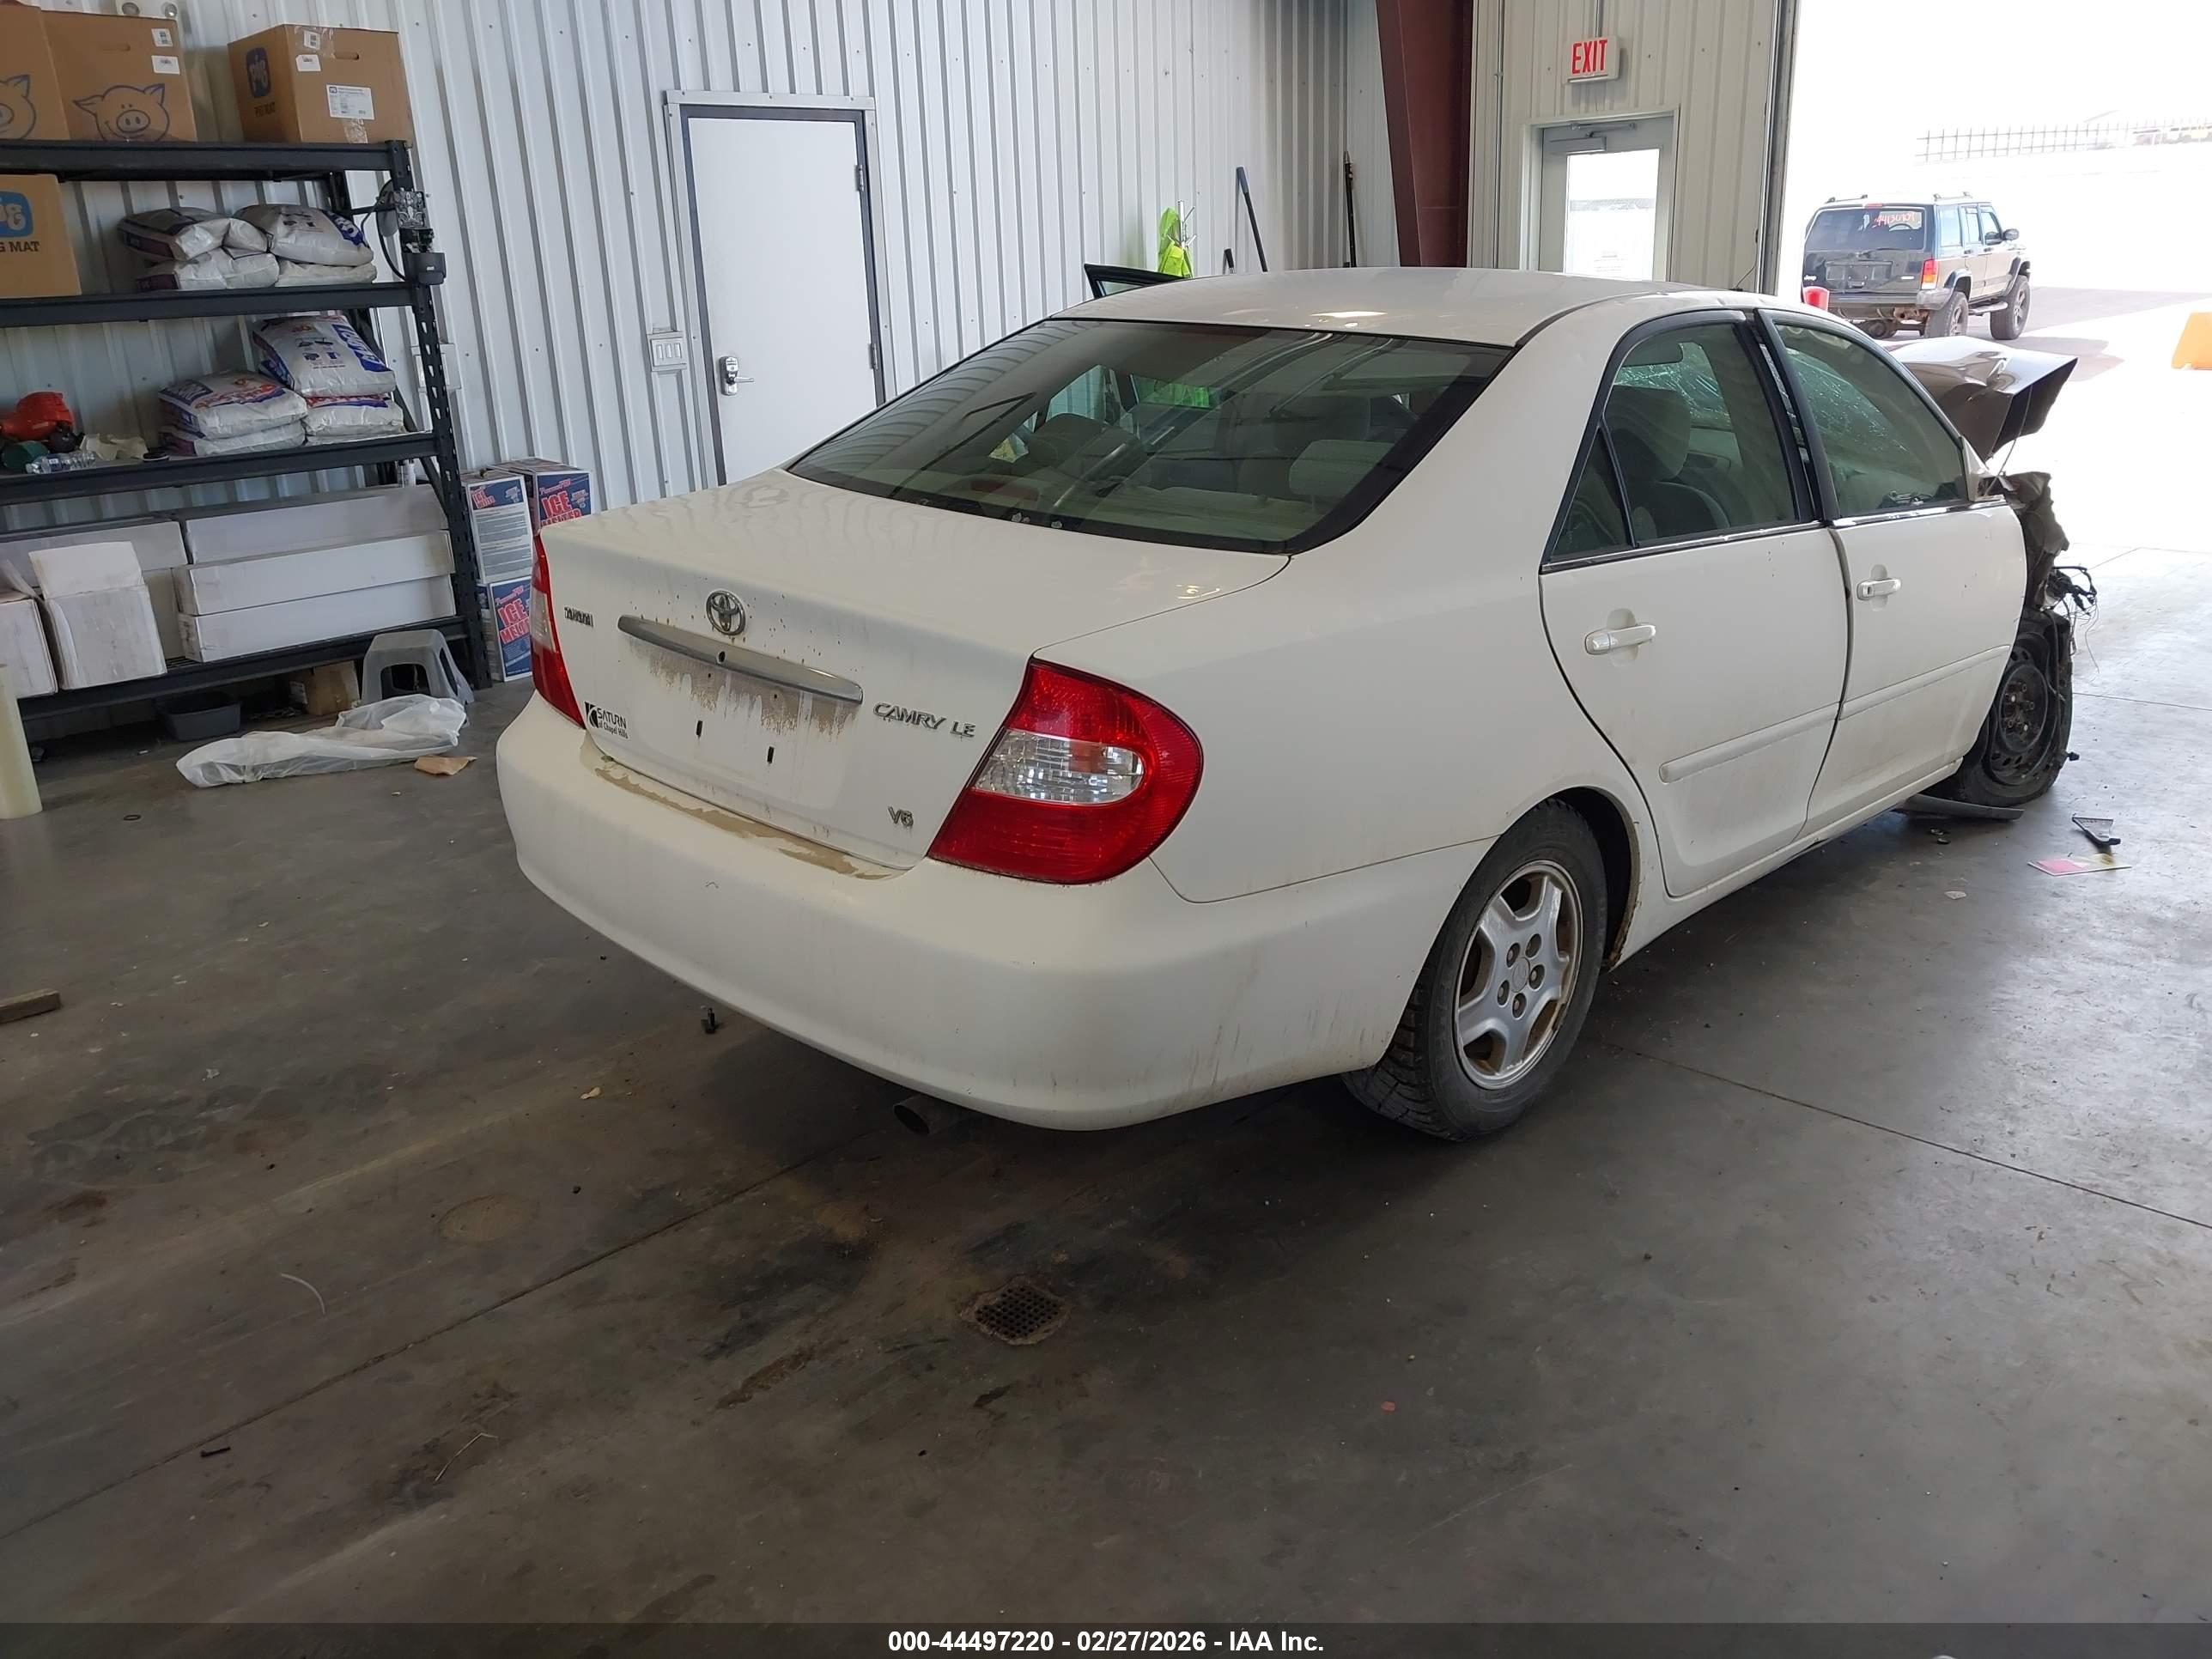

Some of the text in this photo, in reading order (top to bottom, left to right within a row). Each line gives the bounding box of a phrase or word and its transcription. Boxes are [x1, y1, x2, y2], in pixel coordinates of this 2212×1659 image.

[1571, 40, 1608, 75] EXIT
[8, 241, 40, 252] MAT
[541, 490, 574, 518] ICE
[497, 598, 530, 628] ICE
[597, 708, 627, 729] SATURN
[604, 721, 617, 735] Chapel
[873, 702, 976, 738] CAMRY LE
[888, 805, 914, 827] V6
